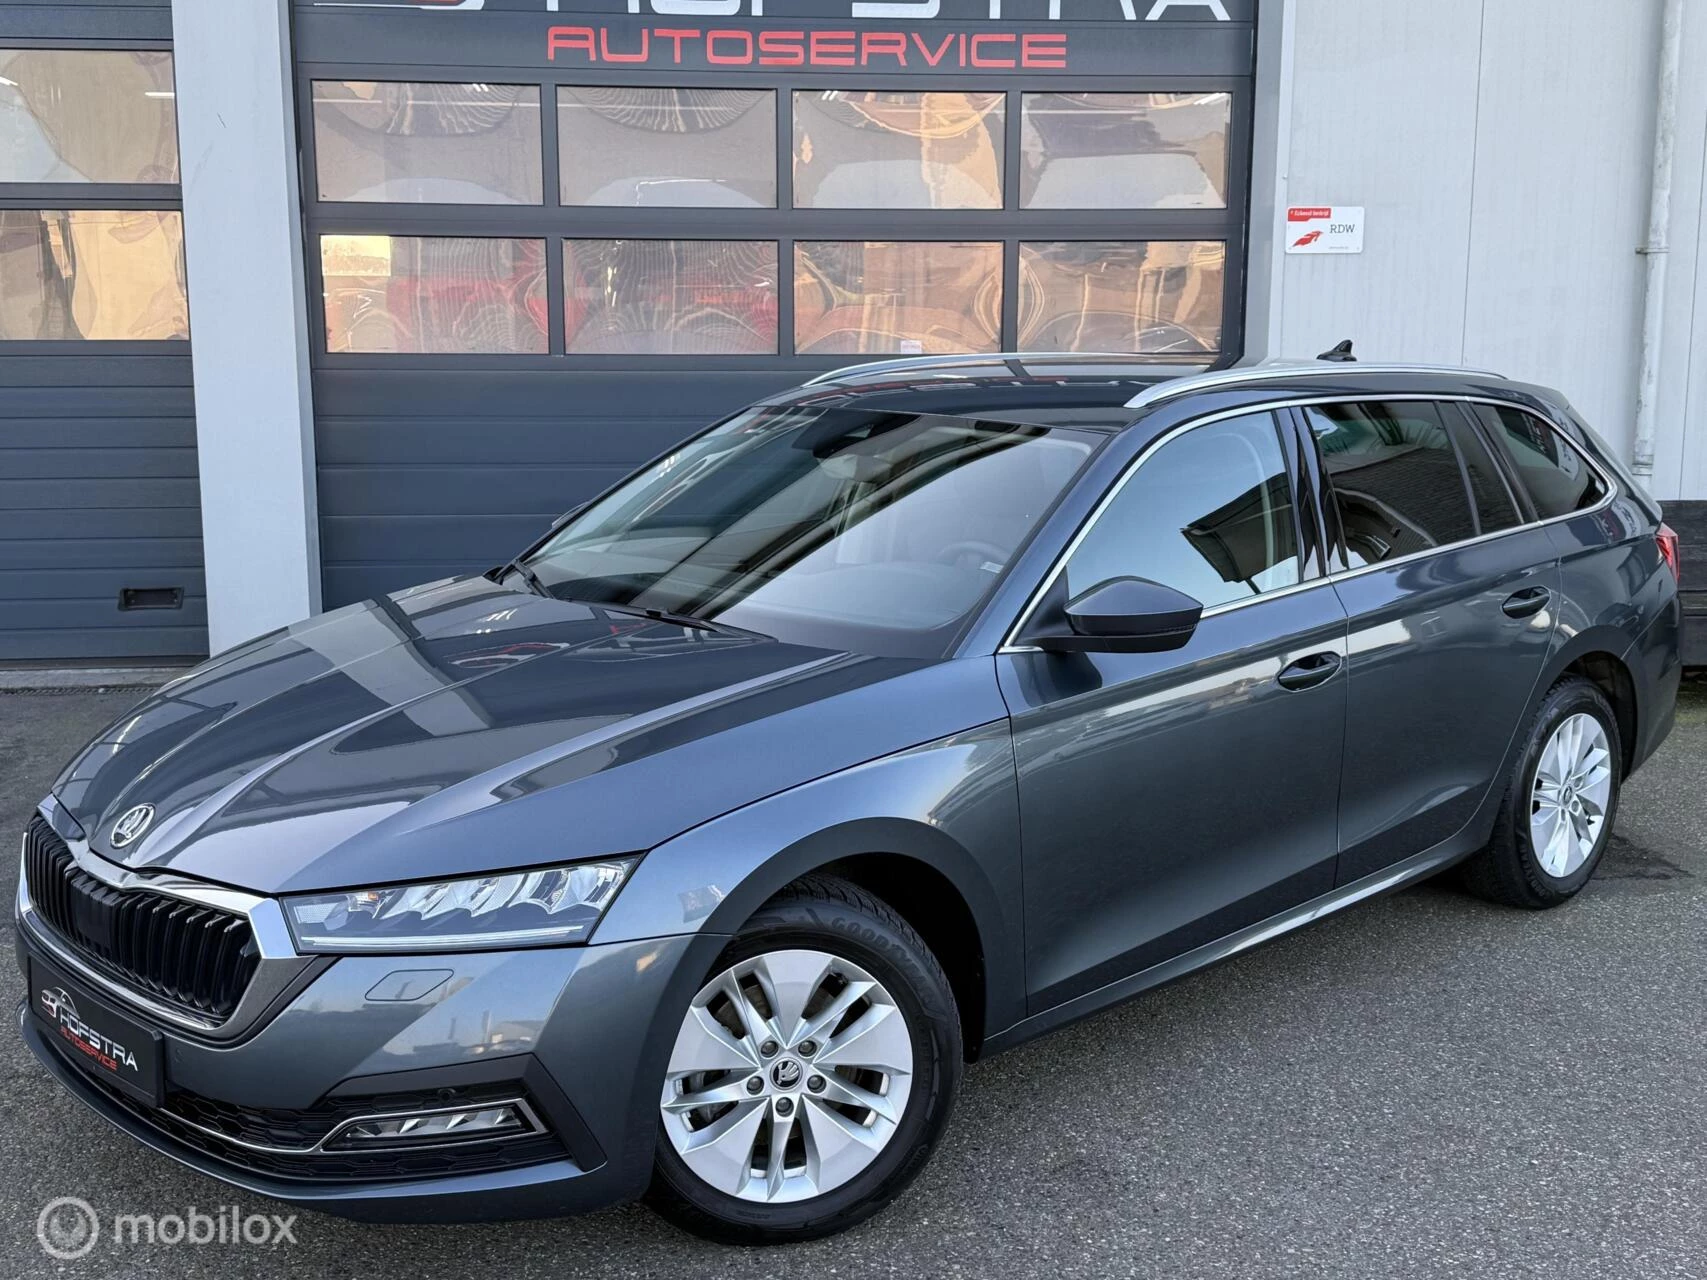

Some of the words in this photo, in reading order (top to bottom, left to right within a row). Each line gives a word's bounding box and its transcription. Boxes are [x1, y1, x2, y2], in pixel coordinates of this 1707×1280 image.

[547, 26, 1067, 68] AUTOSERVICE
[1329, 224, 1355, 233] RDW
[60, 1005, 138, 1071] HOFSTRA
[60, 1025, 117, 1071] AUTOSERVICE
